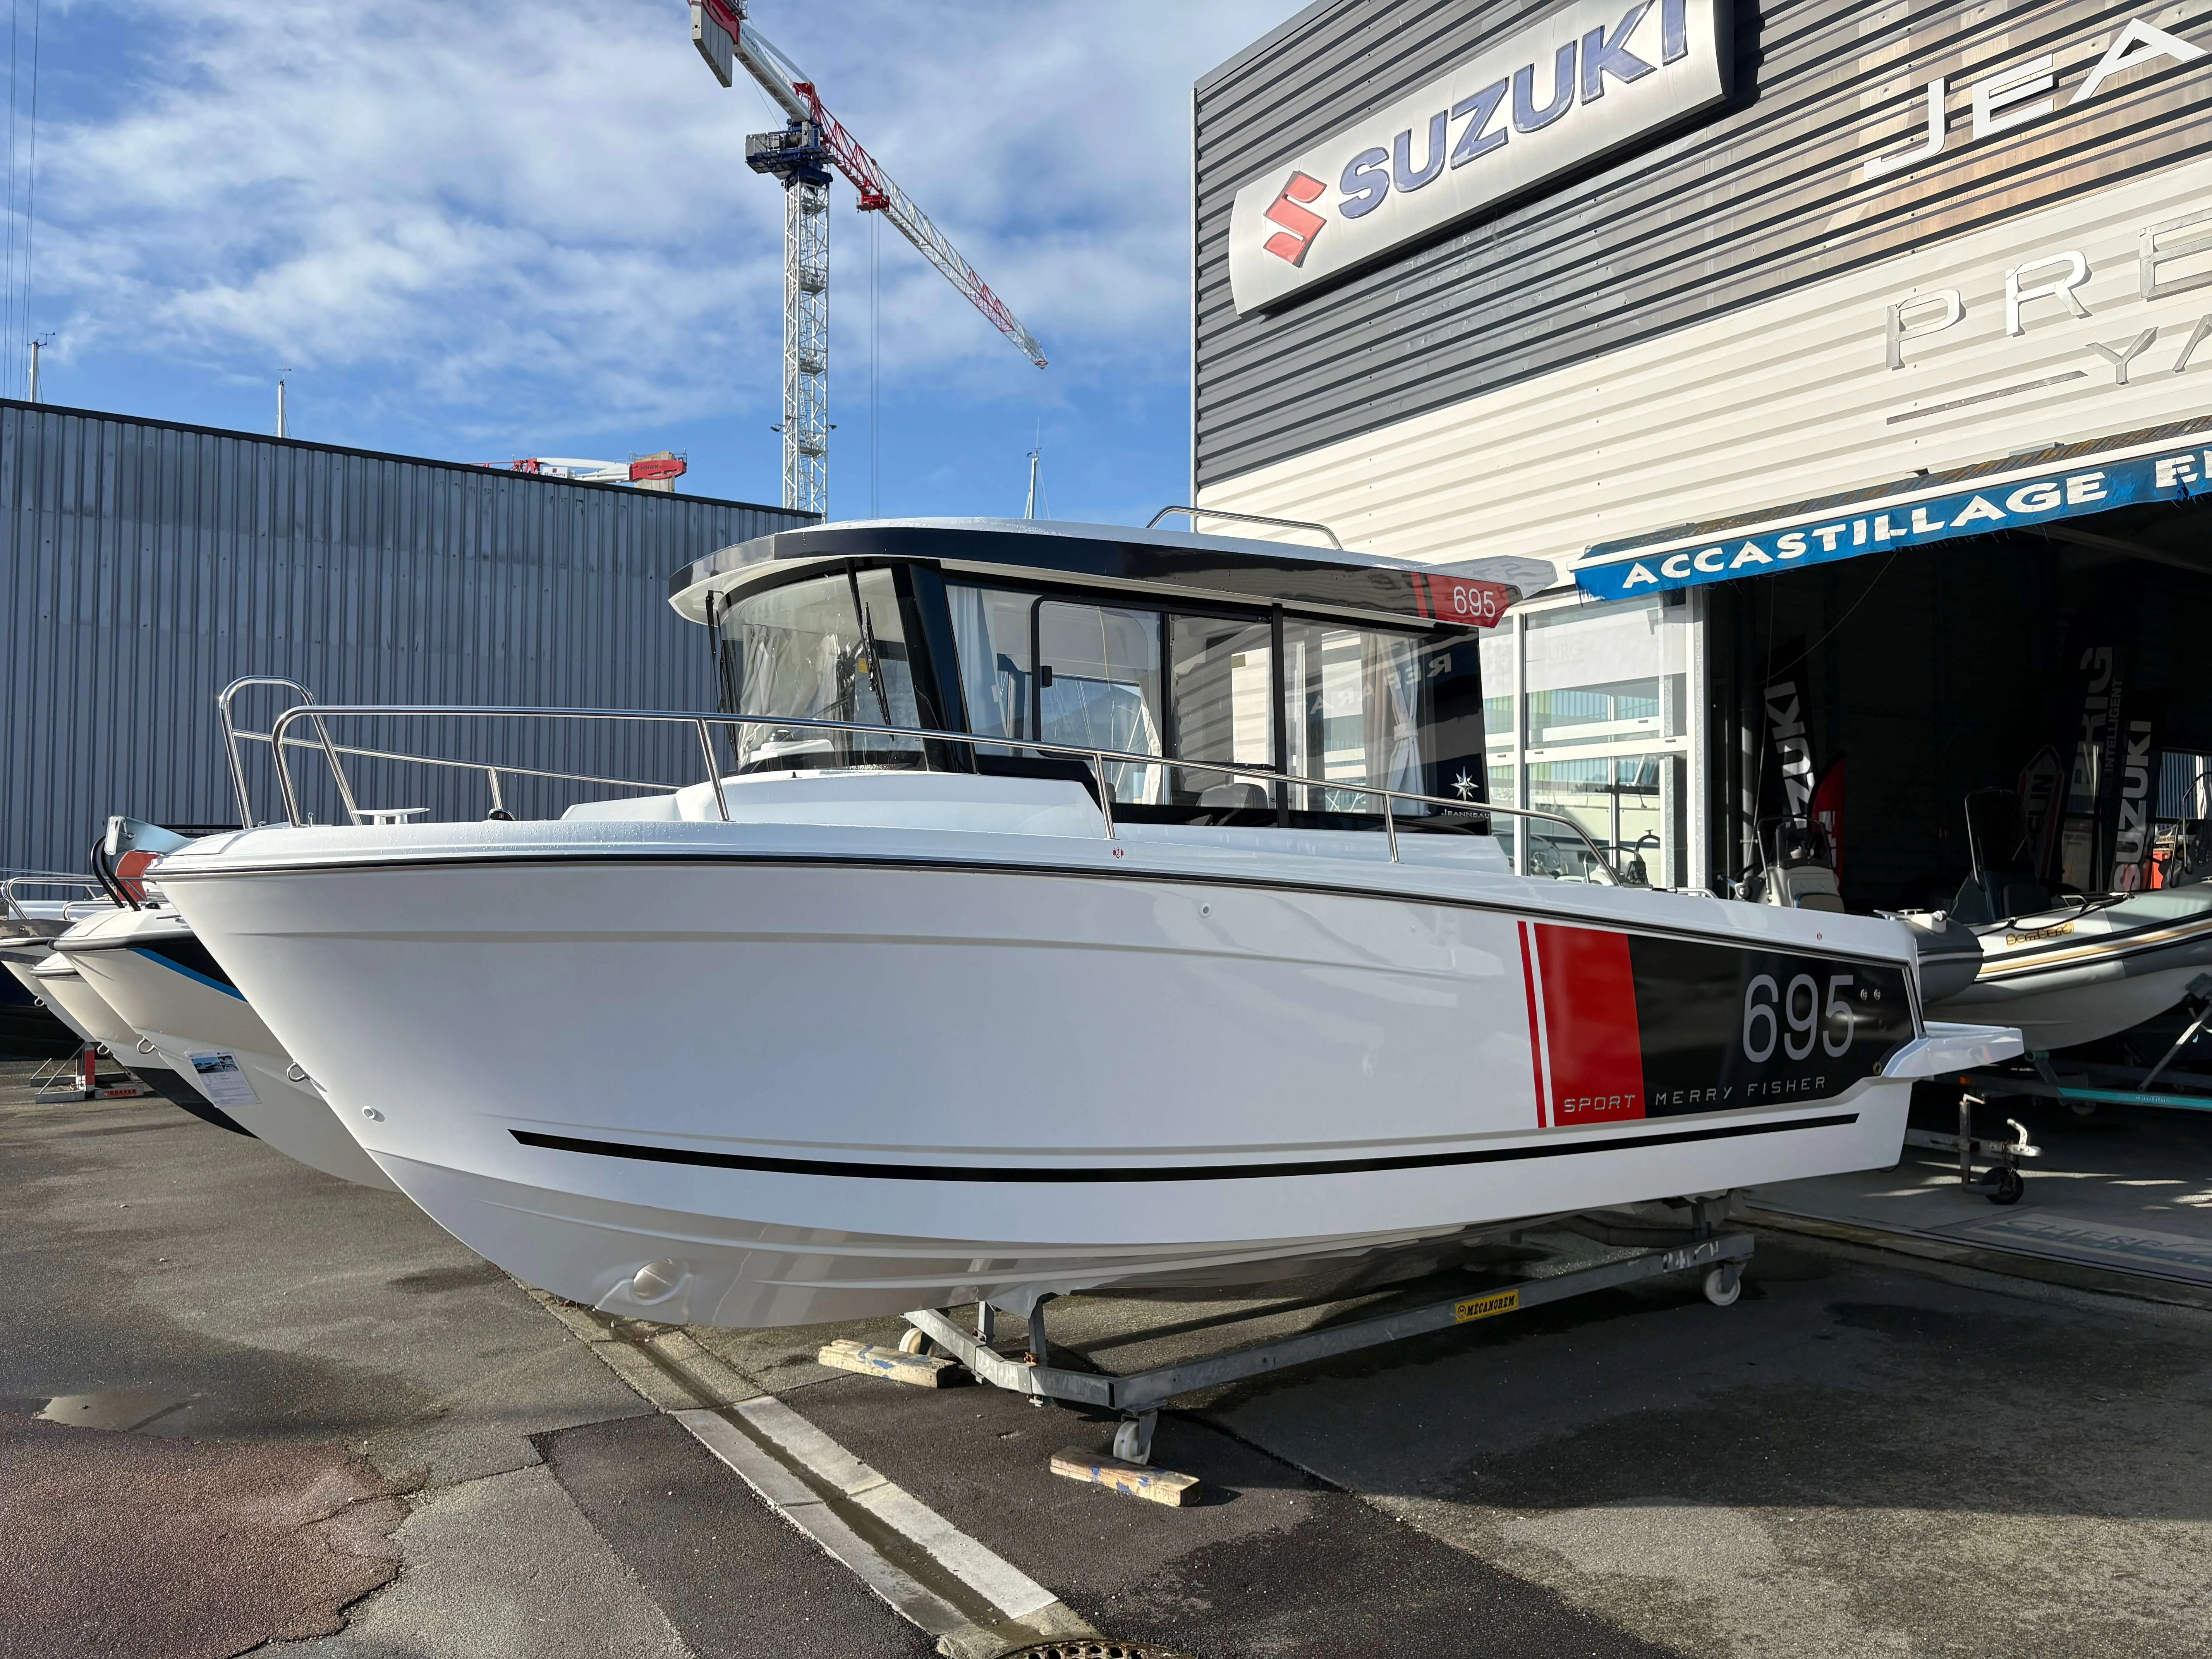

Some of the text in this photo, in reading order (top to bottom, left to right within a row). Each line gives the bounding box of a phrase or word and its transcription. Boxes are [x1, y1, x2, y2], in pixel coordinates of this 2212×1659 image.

[1338, 0, 1689, 220] SUZUKI
[1863, 18, 2211, 180] JEA
[1886, 207, 2212, 369] PRE
[1622, 450, 2212, 589] ACCASTILLAGE E
[1453, 586, 1496, 618] 695
[1441, 809, 1490, 819] JEANNEAU
[1764, 680, 1815, 830] ZUKI
[2113, 720, 2152, 891] SUZUKI
[1743, 974, 1854, 1063] 695
[1563, 1076, 1825, 1113] SPORT MERRY FISHER
